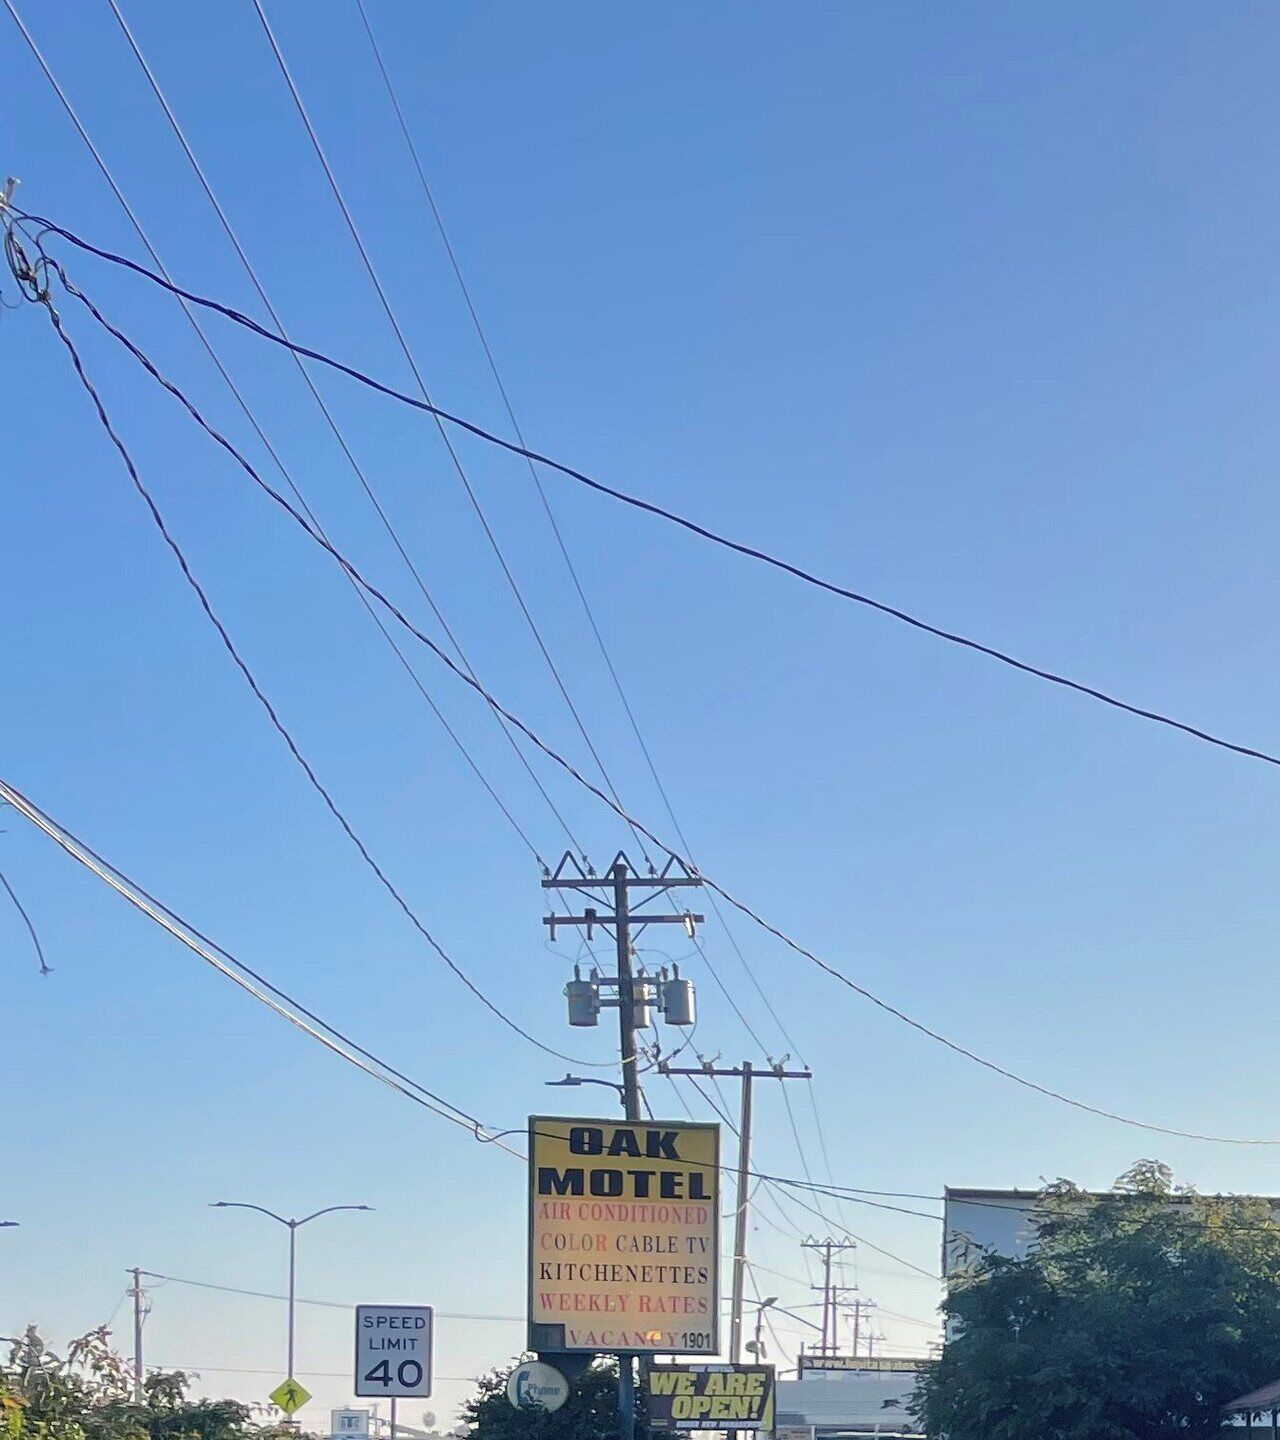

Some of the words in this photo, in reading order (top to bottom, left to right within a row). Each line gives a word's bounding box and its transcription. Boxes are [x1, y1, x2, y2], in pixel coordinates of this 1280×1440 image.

[569, 1127, 680, 1160] OAK
[538, 1167, 712, 1200] MOTEL
[539, 1202, 571, 1220] AIR
[578, 1202, 708, 1225] CONDITIONED
[541, 1232, 608, 1252] COLOR
[615, 1234, 679, 1254] CABLE
[686, 1237, 710, 1254] TV
[539, 1262, 709, 1284] KITCHENETTES
[539, 1292, 633, 1313] WEEKLY
[638, 1294, 709, 1314] RATES
[363, 1315, 426, 1330] SPEED
[369, 1337, 419, 1351] LIMIT
[569, 1329, 680, 1348] VACANCY
[681, 1332, 712, 1349] 1901
[364, 1359, 424, 1388] 40
[650, 1371, 698, 1395] WE
[703, 1372, 767, 1396] ARE
[671, 1395, 762, 1419] OPEN!
